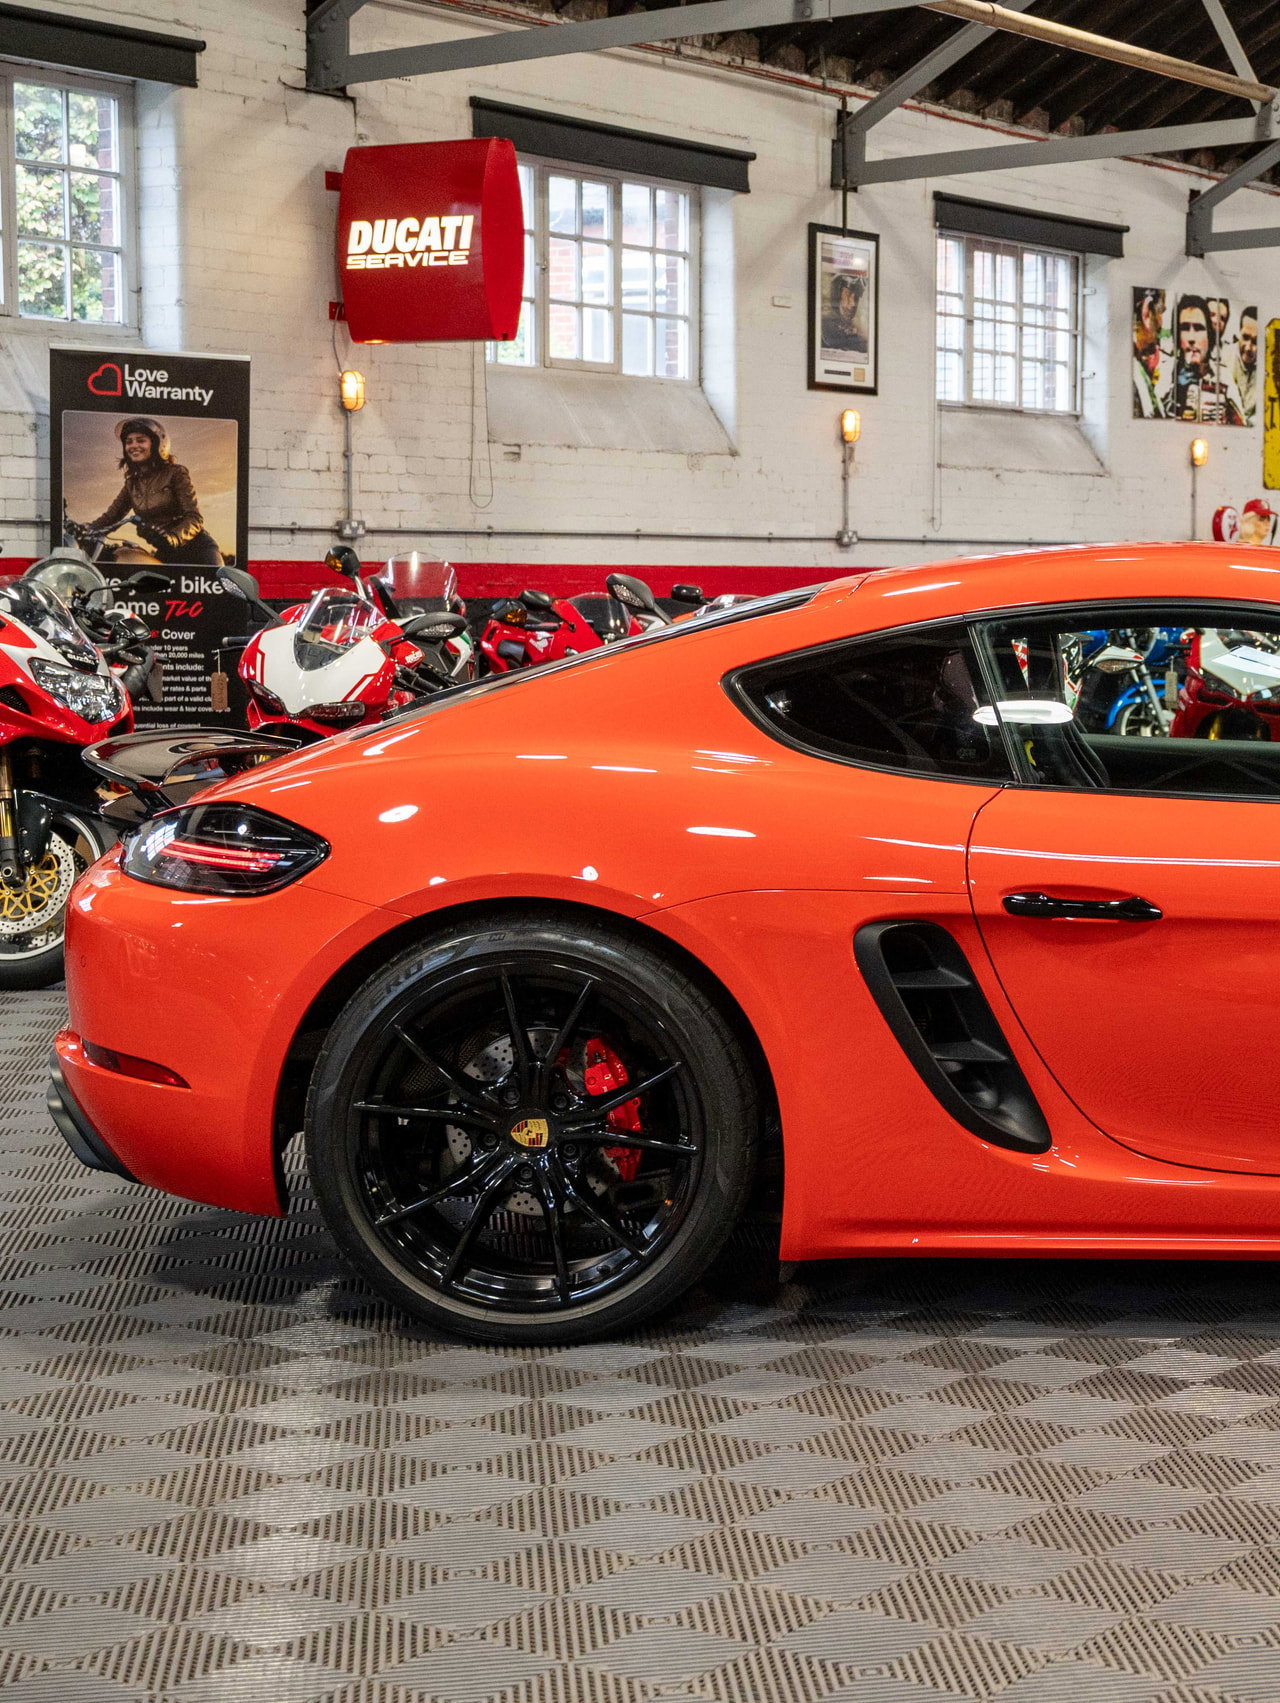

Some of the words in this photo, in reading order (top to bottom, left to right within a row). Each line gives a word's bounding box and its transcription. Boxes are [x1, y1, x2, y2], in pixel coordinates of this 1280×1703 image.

[347, 215, 475, 255] DUCATI
[346, 250, 470, 270] SERVICE
[124, 364, 169, 382] Love
[125, 381, 214, 406] Warranty
[181, 576, 224, 595] bike
[114, 601, 160, 616] ome
[165, 600, 204, 621] TLC
[161, 629, 196, 640] Cover
